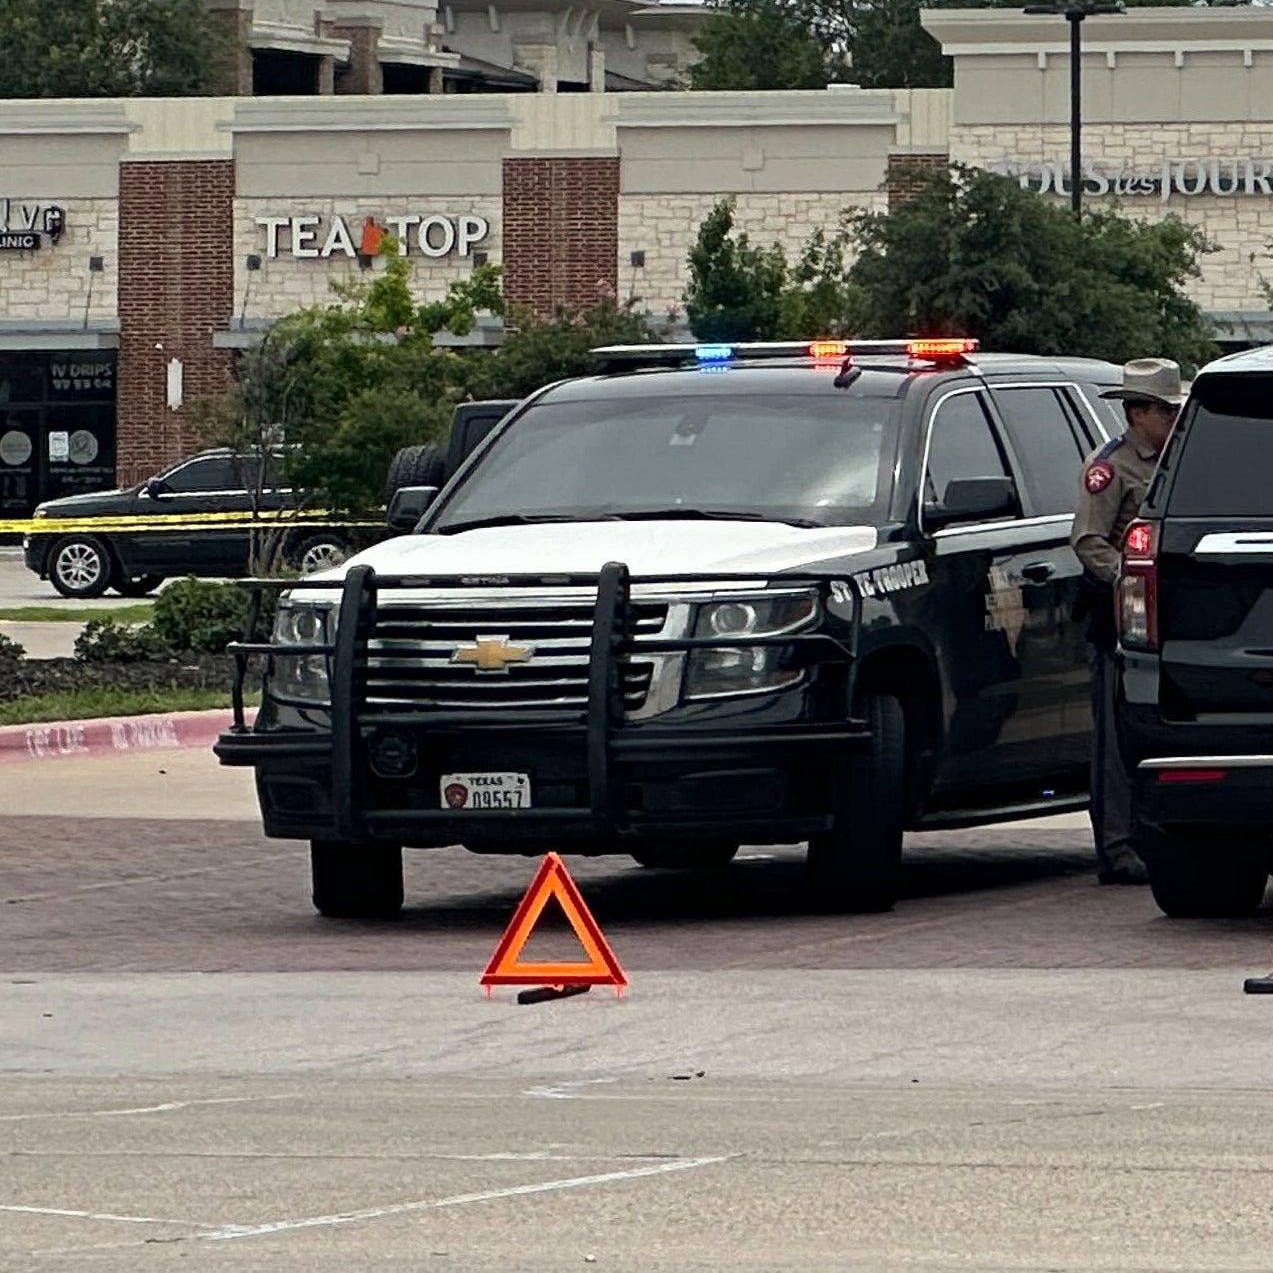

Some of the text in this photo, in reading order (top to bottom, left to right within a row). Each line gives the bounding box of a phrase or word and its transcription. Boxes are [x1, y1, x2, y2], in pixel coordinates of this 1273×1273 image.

[1113, 160, 1155, 195] les
[255, 215, 488, 258] TEA TOP
[468, 776, 503, 786] TEXAS
